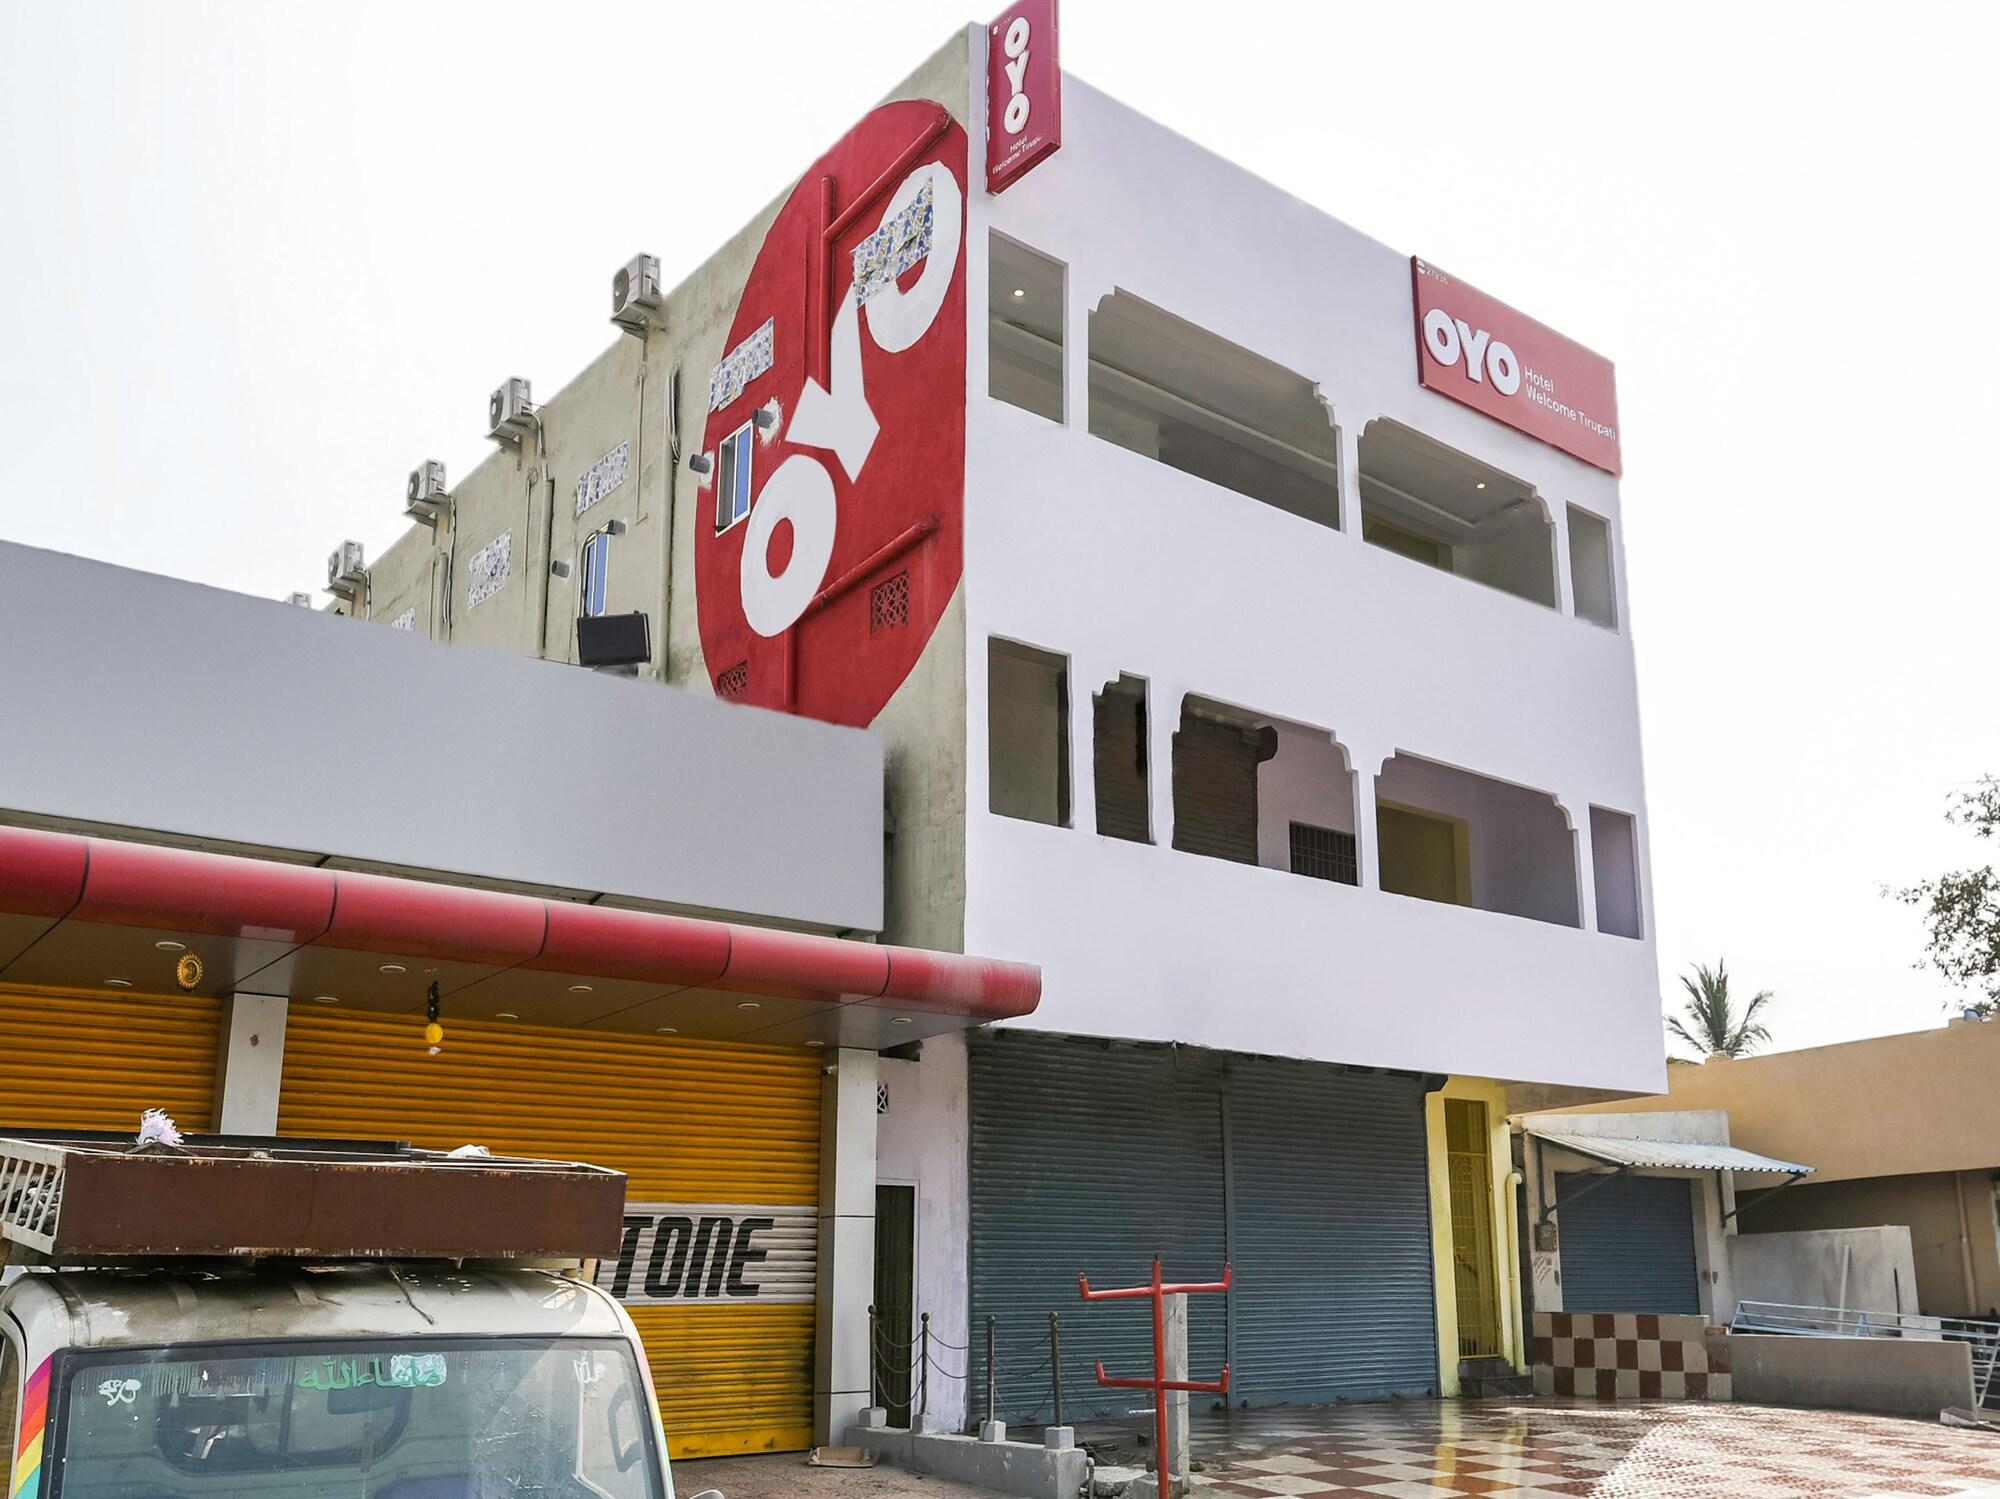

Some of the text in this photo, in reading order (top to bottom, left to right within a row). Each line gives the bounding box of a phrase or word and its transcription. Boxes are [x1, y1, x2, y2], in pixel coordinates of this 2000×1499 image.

[1004, 16, 1031, 135] OYO
[1010, 134, 1027, 153] Hotel
[1423, 308, 1521, 396] OYO
[1524, 365, 1554, 393] Hotel
[1526, 383, 1617, 441] Welcome Tirupati
[593, 1216, 774, 1298] TONE
